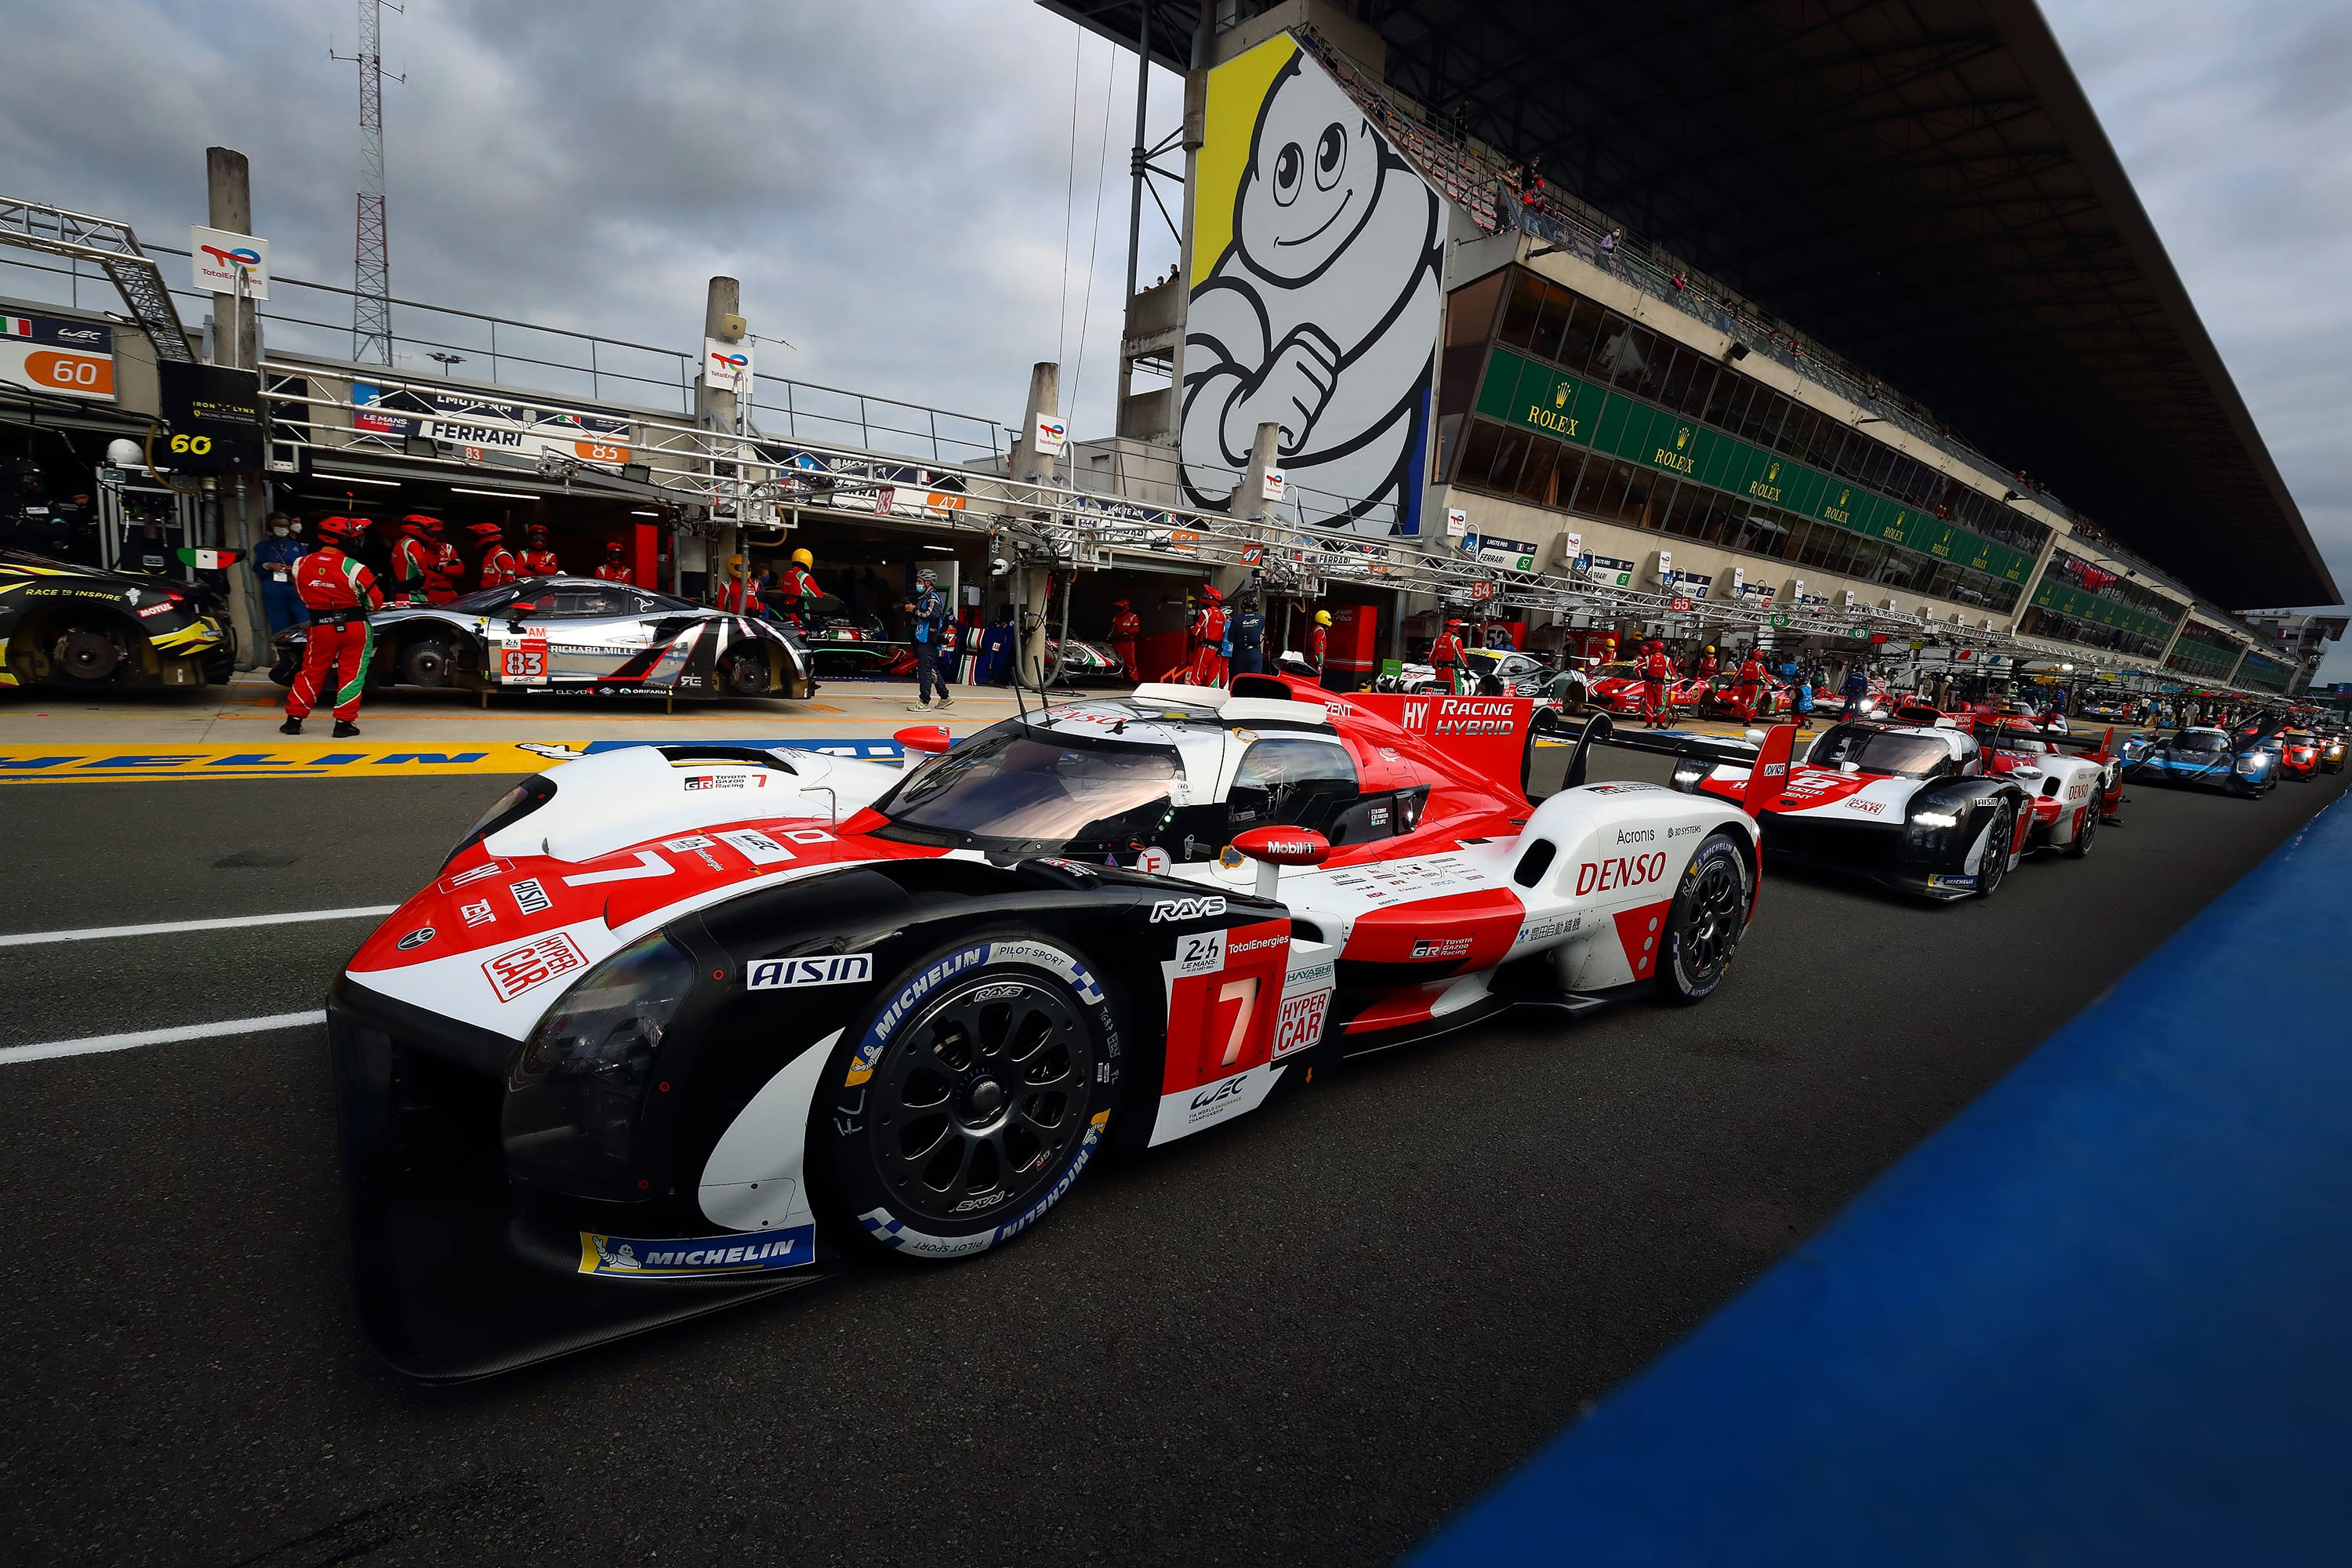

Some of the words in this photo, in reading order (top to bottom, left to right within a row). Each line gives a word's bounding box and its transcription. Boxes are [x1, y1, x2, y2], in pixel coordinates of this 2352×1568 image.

[201, 268, 263, 285] TotalEnies
[53, 359, 97, 385] 60
[232, 406, 256, 415] LYNX
[377, 416, 408, 426] MANS
[1526, 405, 1580, 437] ROLEX
[432, 421, 523, 447] FERRARI
[170, 434, 212, 455] 60
[465, 447, 481, 460] 83
[1654, 448, 1695, 474] ROLEX
[1749, 481, 1782, 502] ROLEX
[876, 491, 892, 514] 83
[1824, 506, 1850, 524] ROLEX
[1883, 527, 1904, 543] ROLEX
[1243, 549, 1261, 563] 47
[1479, 553, 1505, 564] FERRARI
[1931, 543, 1951, 557] ROLEX
[1520, 559, 1530, 568] 52
[74, 590, 123, 601] INSPIRE
[1474, 582, 1490, 597] 54
[140, 602, 174, 618] MOTUL
[1673, 598, 1690, 611] 55
[528, 627, 546, 637] AM
[1855, 629, 1865, 637] 51
[550, 645, 600, 654] RICHARD
[604, 647, 637, 655] MILLE
[506, 652, 543, 675] 83
[1325, 701, 1352, 718] ZENT
[1403, 700, 1429, 729] HY
[1439, 699, 1515, 717] RACING
[1434, 719, 1515, 737] HYBRID
[684, 779, 713, 790] GR
[751, 774, 768, 788] 7
[2069, 784, 2089, 800] DENSO
[1848, 802, 1880, 814] CAR
[1976, 798, 1998, 807] AISIN
[1616, 827, 1655, 846] Acronis
[1675, 828, 1681, 837] 3D
[1680, 825, 1702, 836] SYSTEMS
[1267, 840, 1303, 855] Mobil
[1305, 842, 1315, 854] 1
[1702, 841, 1733, 861] MICHELIN
[561, 850, 677, 887] 7
[1147, 857, 1161, 873] F
[1575, 851, 1667, 897] DENSO
[1945, 877, 1975, 886] MICHELIN
[512, 880, 549, 913] AISIN
[460, 898, 498, 928] ZENT
[1150, 895, 1227, 924] RAYS
[1228, 935, 1290, 955] TotalEnergies
[1443, 942, 1471, 951] GAZOO
[1445, 936, 1473, 945] TOYOTA
[534, 936, 579, 975] HYPER
[999, 946, 1032, 956] PILOT
[1032, 949, 1066, 967] SPORT
[1183, 936, 1219, 963] 24h
[1411, 945, 1441, 958] GR
[1440, 949, 1468, 958] Racing
[751, 956, 869, 986] AISIN
[1192, 958, 1216, 968] MANS
[492, 948, 549, 996] CAR
[1286, 964, 1332, 982] HAYASHI
[875, 947, 981, 1041] MICHELIN
[975, 985, 1023, 1002] RAYS
[1281, 993, 1327, 1022] HYPER
[1218, 976, 1261, 1069] 7
[1277, 1011, 1322, 1051] CAR
[1190, 1075, 1248, 1111] WEC
[1197, 1105, 1215, 1117] WORLD
[1215, 1096, 1242, 1110] ENDURANCE
[1188, 1107, 1224, 1124] CHAMPIONSHIP
[956, 1190, 1006, 1211] RAYS
[1001, 1149, 1090, 1241] MICHELIN
[645, 1239, 796, 1265] MICHELIN
[912, 1240, 950, 1253] SPORT
[951, 1239, 984, 1253] PILOT
